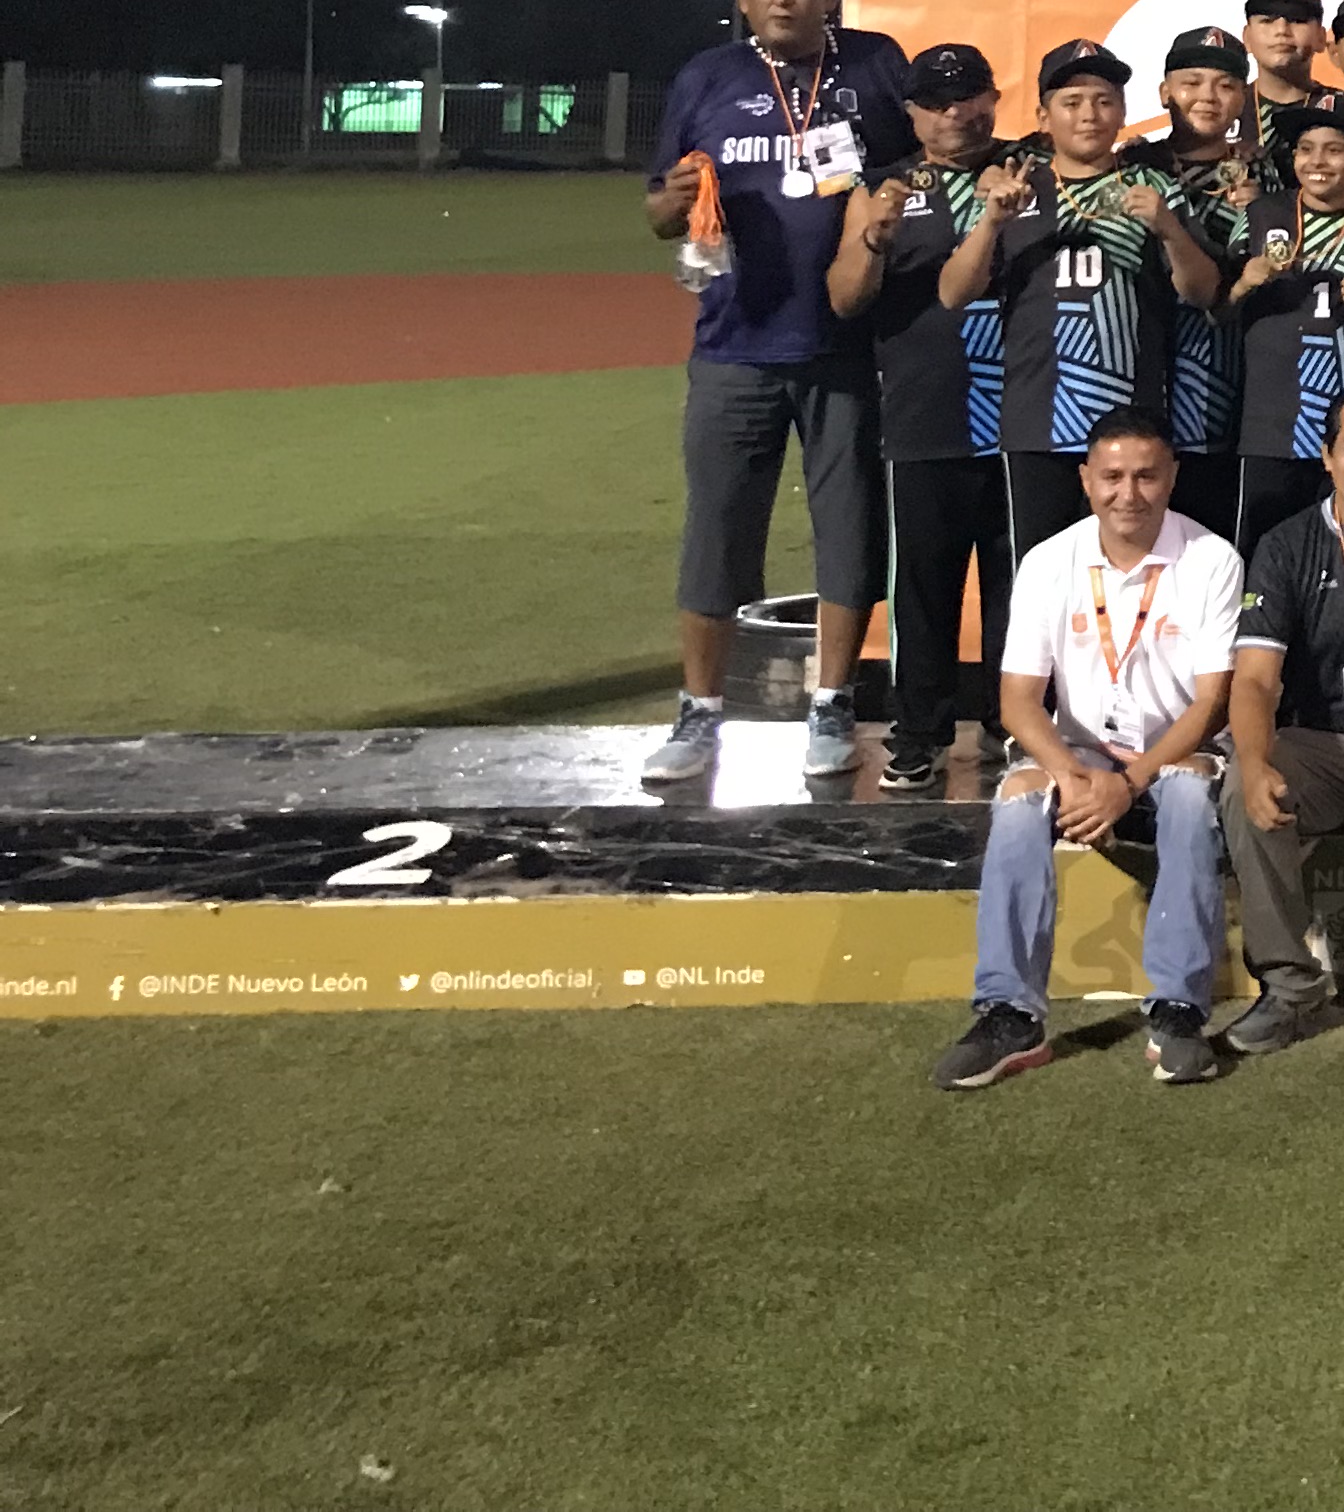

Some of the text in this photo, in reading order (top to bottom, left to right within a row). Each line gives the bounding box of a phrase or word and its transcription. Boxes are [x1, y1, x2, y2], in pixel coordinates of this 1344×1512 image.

[722, 135, 770, 165] san
[1055, 244, 1104, 288] 10
[1312, 281, 1331, 319] 1
[327, 820, 453, 885] 2
[138, 971, 368, 997] @INDE Nuevo León
[430, 970, 594, 994] @nlindeoficial
[656, 966, 765, 989] @NL Inde
